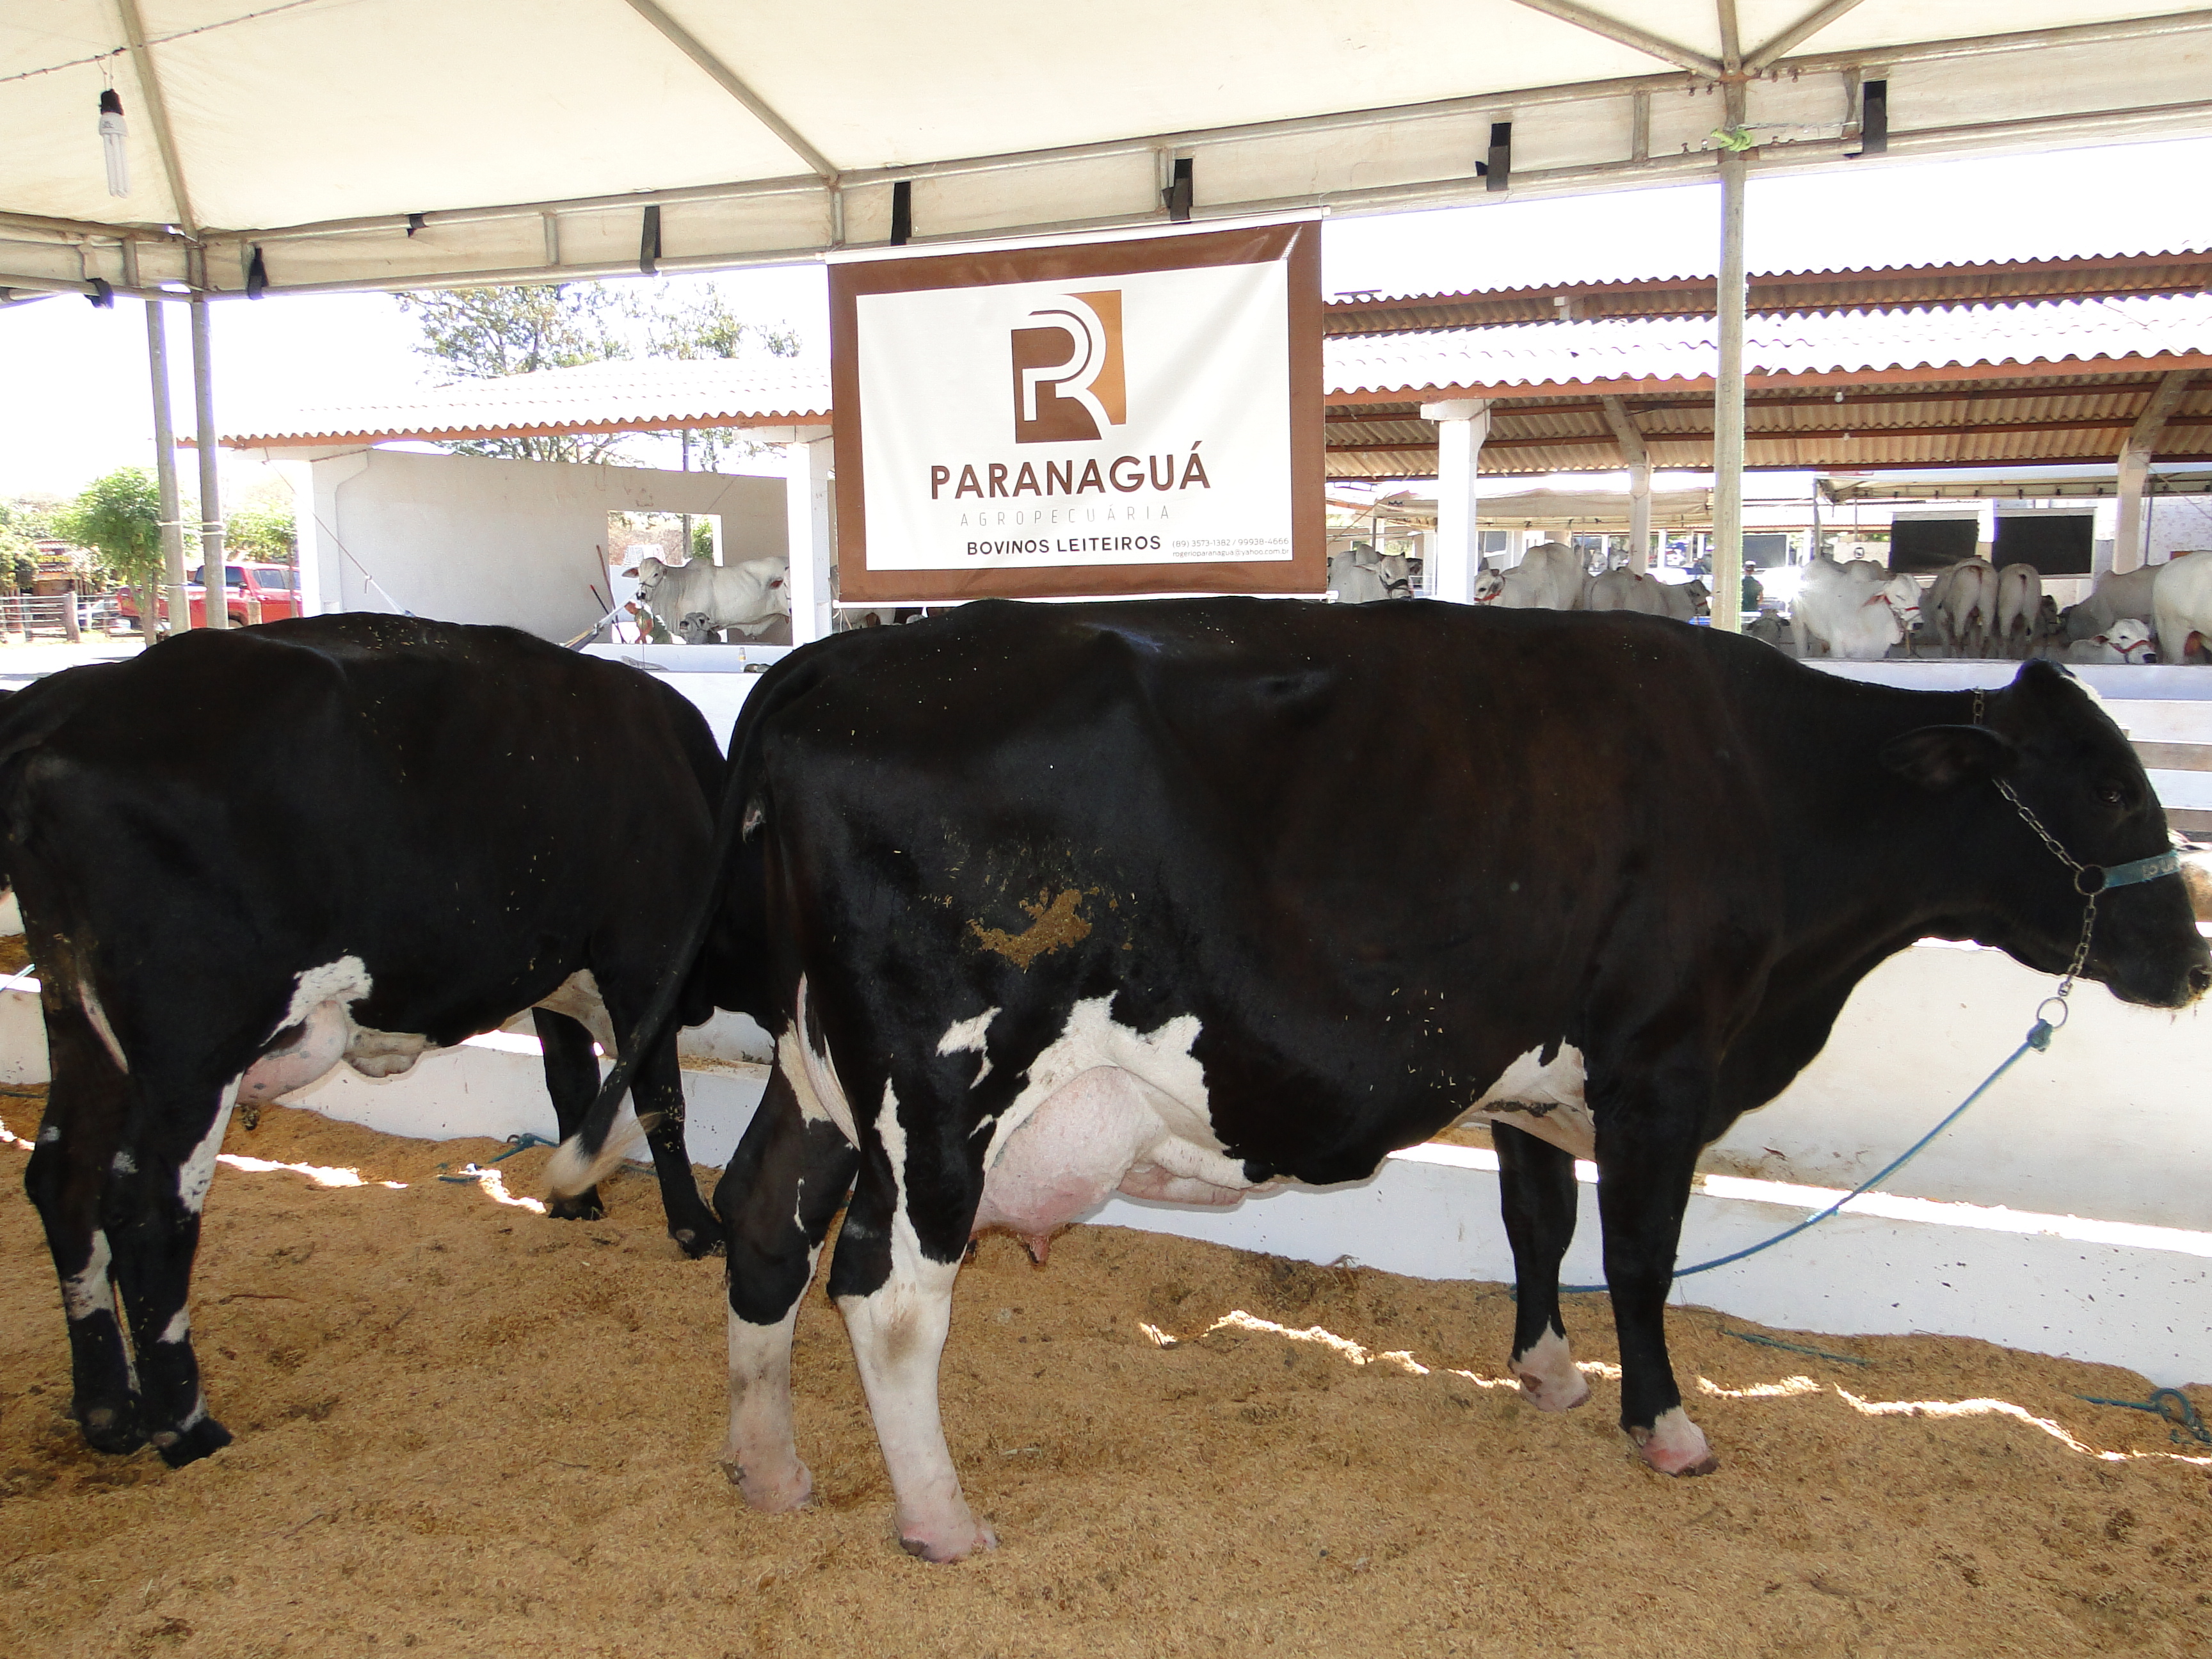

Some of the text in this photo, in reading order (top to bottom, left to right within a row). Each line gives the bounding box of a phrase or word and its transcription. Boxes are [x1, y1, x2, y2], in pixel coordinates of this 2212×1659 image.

[931, 440, 1212, 500] PARANAGUÁ
[960, 504, 1169, 527] AGROPECUÁRIA
[967, 535, 1161, 556] BOVINOS LEITEIROS
[1172, 540, 1190, 549] (89)
[1191, 539, 1231, 547] 3573-1382
[1238, 538, 1289, 546] 99938-4666
[1173, 548, 1289, 558] rogerioparanagua@yahoo.com.br
